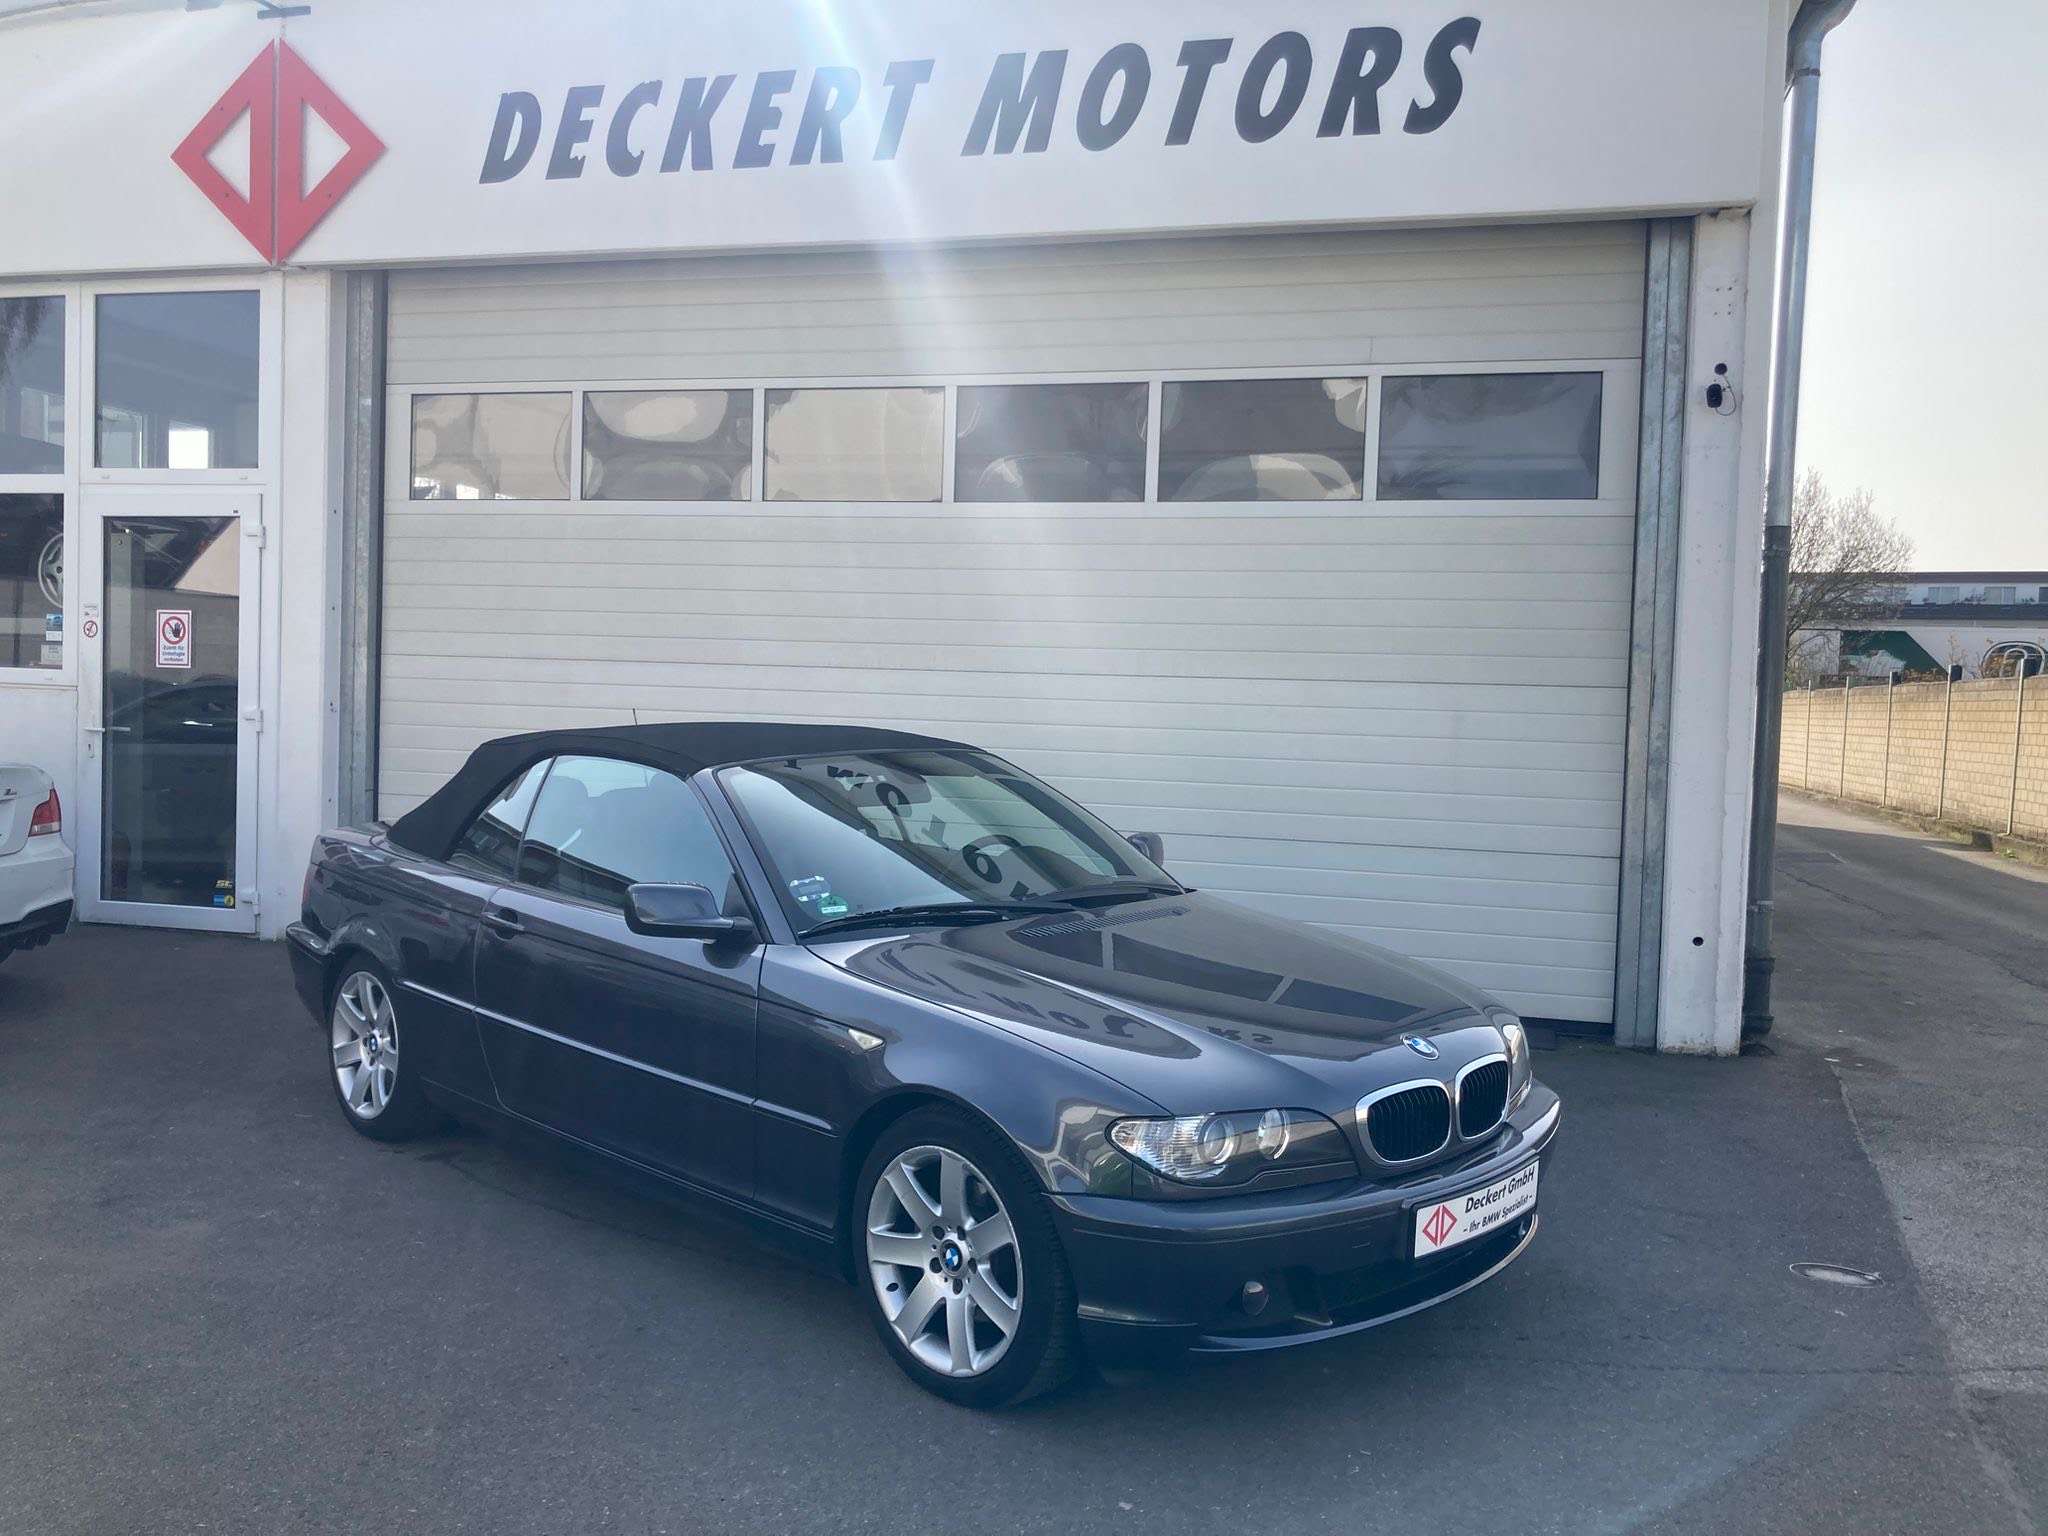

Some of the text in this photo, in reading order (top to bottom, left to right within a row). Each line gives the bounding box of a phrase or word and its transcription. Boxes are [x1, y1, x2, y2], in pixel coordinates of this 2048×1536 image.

[479, 16, 1482, 184] DECKERT MOTORS
[1464, 1165, 1535, 1214] Deckert GmbH
[1469, 1219, 1480, 1233] Ihr
[1481, 1211, 1501, 1228] BMW
